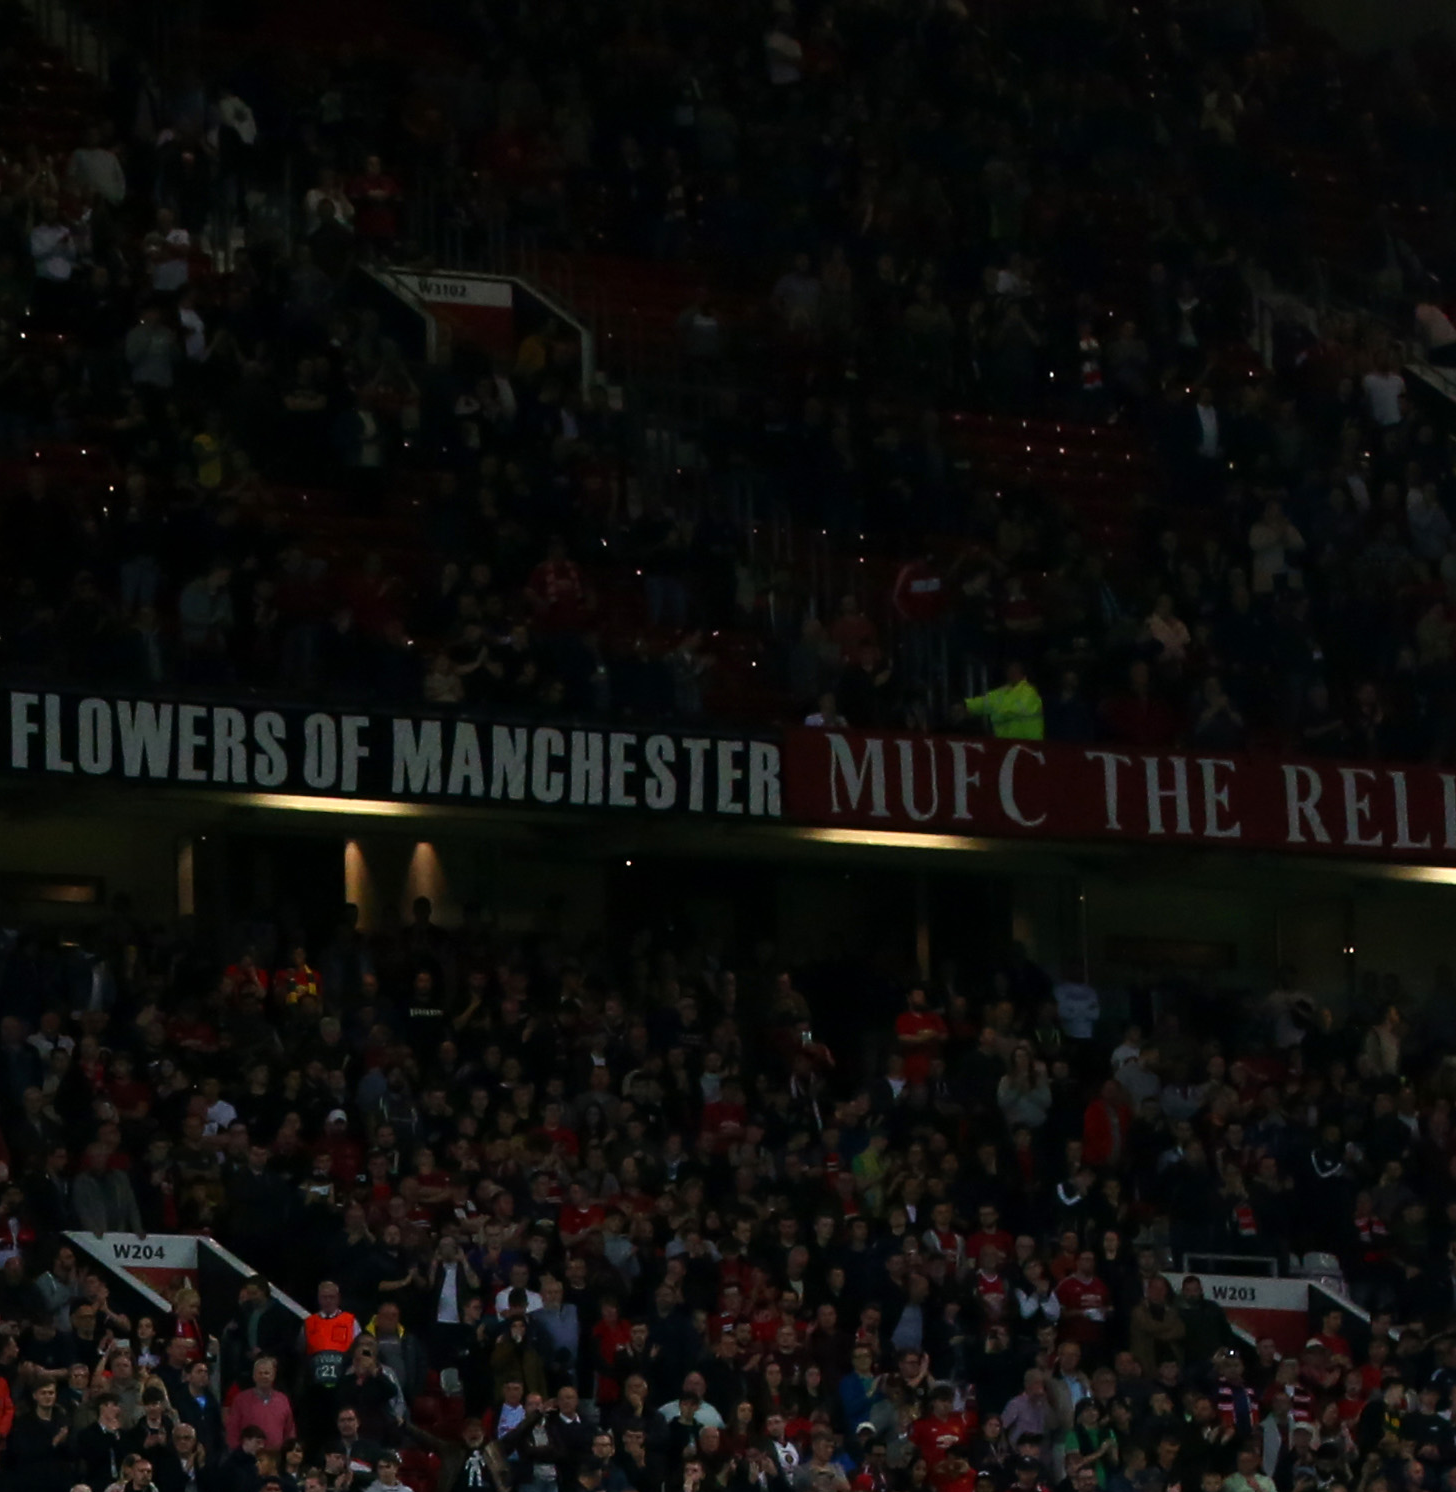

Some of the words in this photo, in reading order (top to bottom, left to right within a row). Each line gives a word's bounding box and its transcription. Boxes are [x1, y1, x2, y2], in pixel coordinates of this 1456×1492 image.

[10, 690, 288, 789] FLOWERS
[303, 711, 371, 793] OF
[391, 717, 783, 819] MANCHESTER
[825, 732, 1048, 828] MUFC
[1084, 748, 1242, 839] THE
[113, 1243, 166, 1260] W204
[1212, 1285, 1256, 1301] W203
